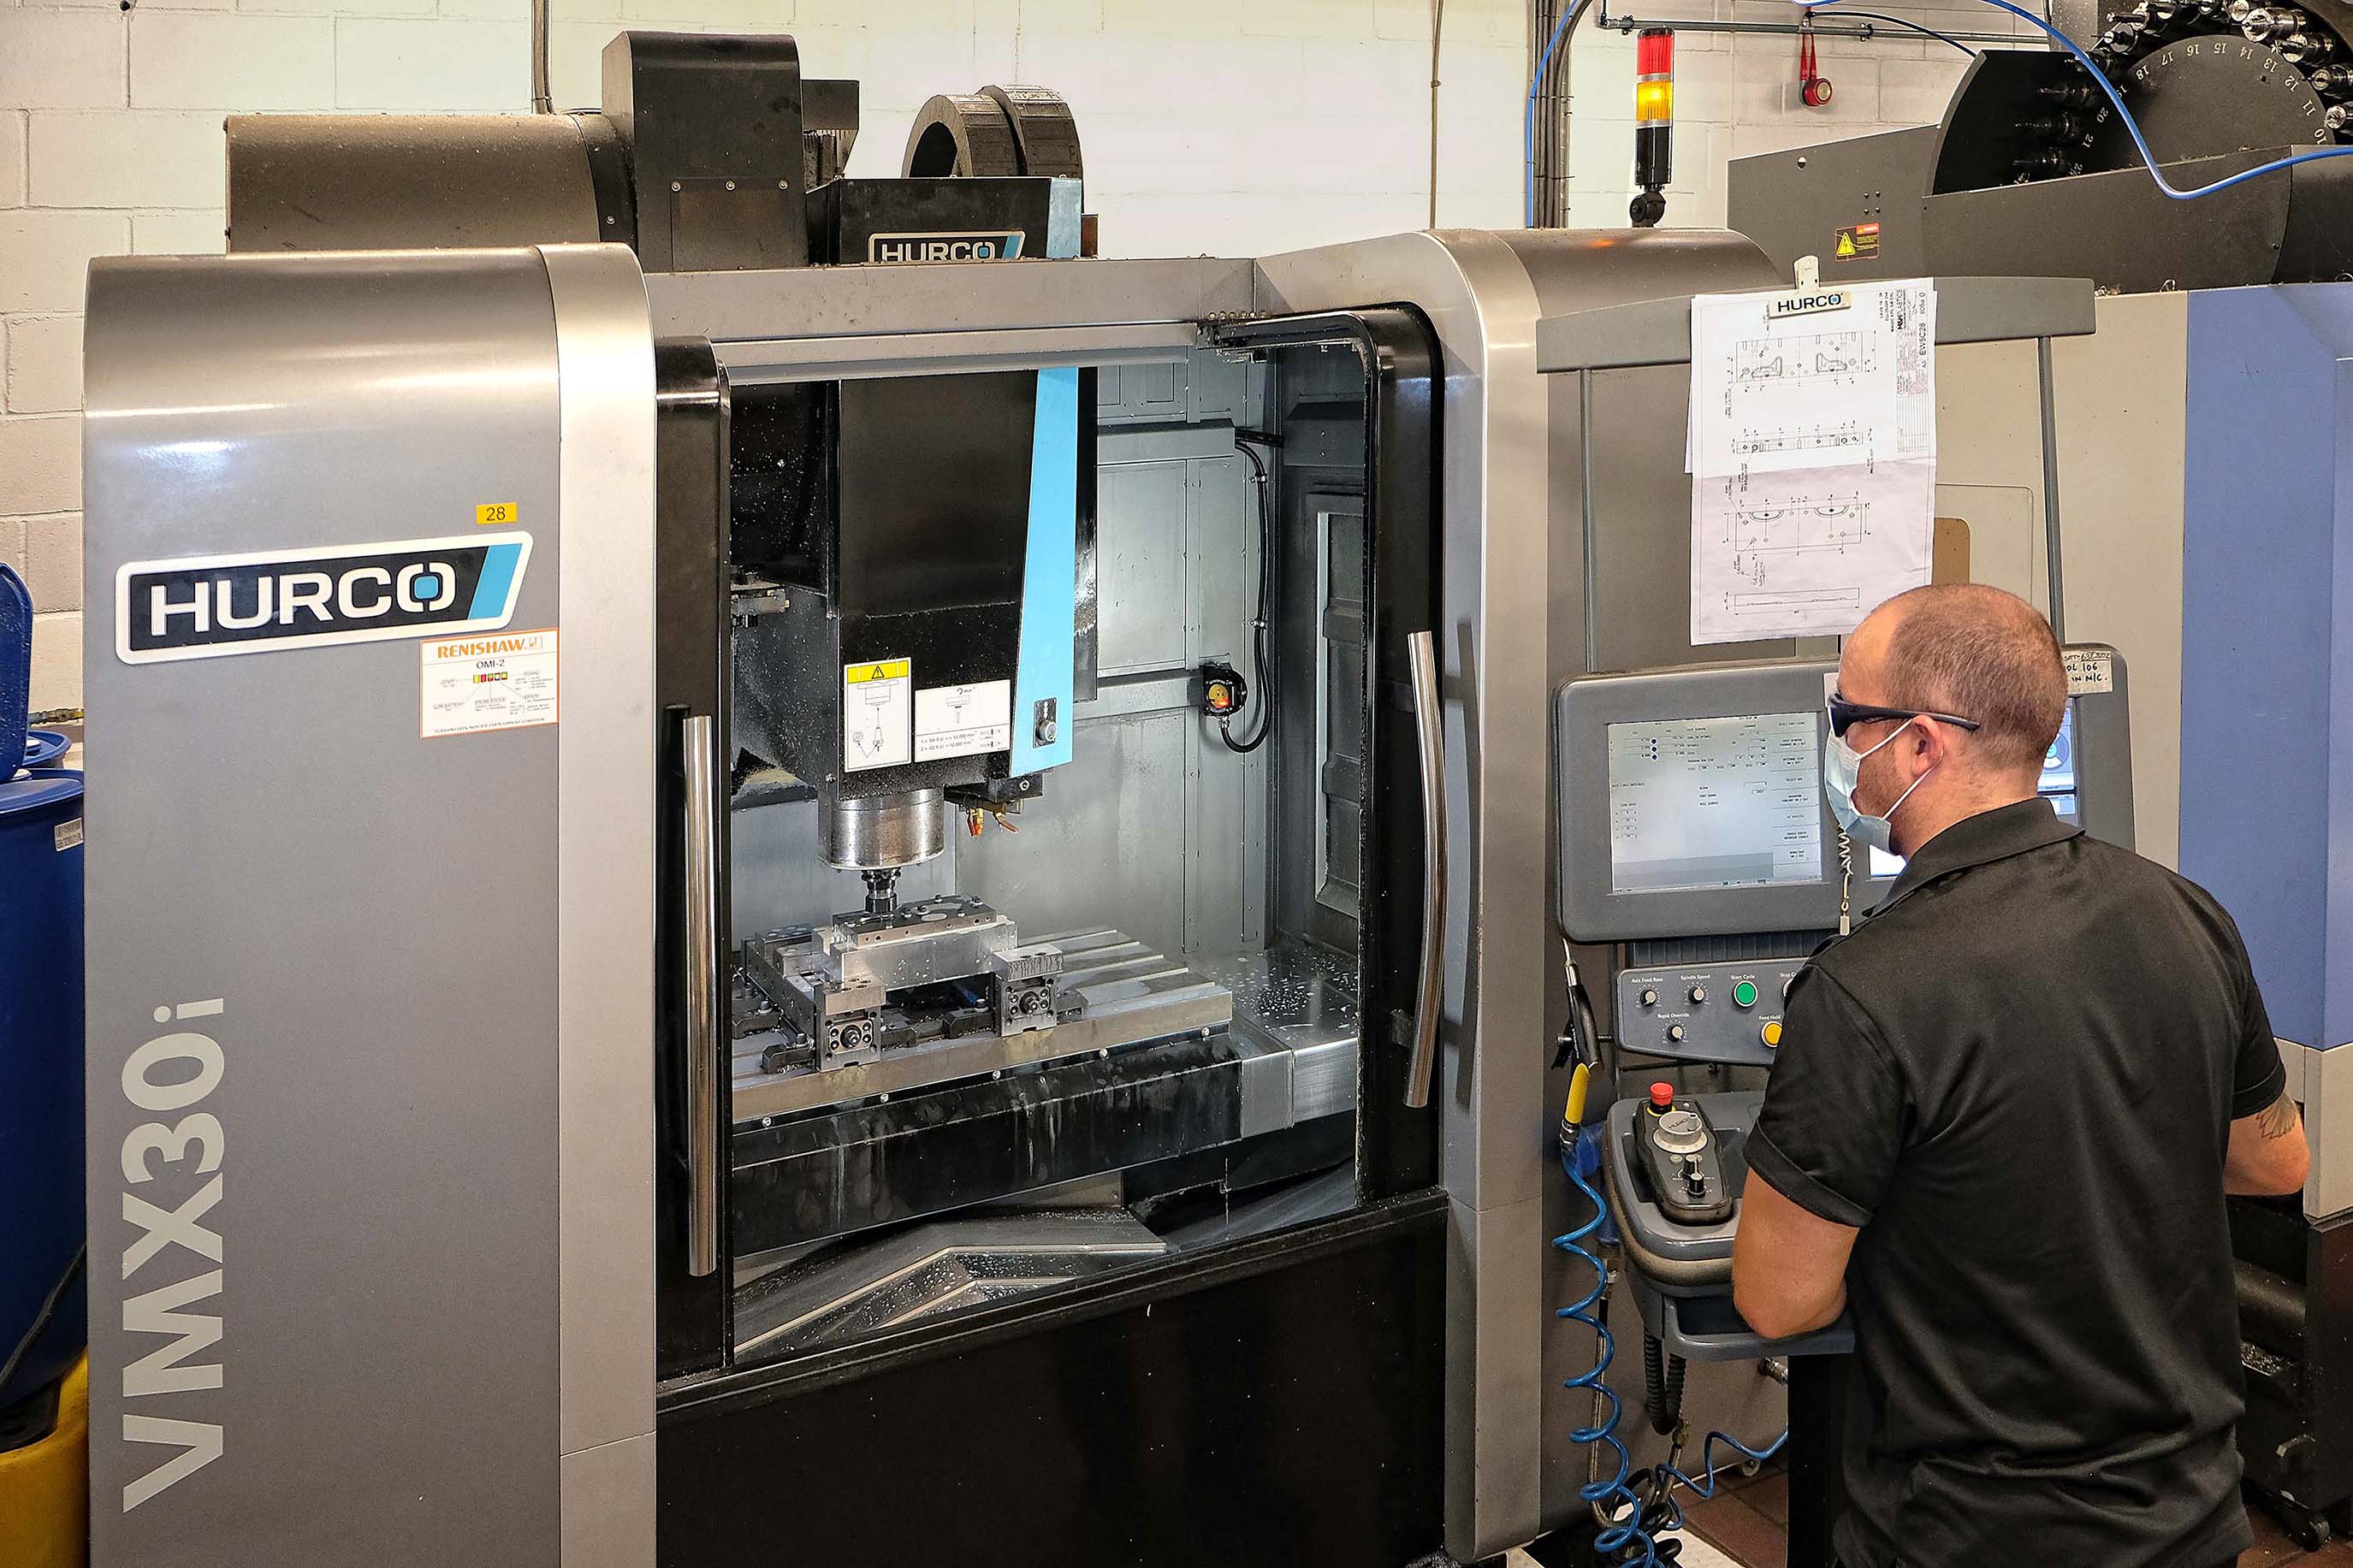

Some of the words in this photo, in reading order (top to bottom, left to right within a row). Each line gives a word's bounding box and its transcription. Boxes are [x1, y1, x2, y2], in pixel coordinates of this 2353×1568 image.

[2186, 44, 2200, 56] 16
[2214, 43, 2227, 54] 15
[2239, 46, 2255, 60] 14
[2161, 51, 2174, 66] 17
[2263, 57, 2279, 74] 13
[2136, 64, 2149, 80] 18
[2285, 74, 2301, 92] 12
[2096, 107, 2108, 123] 20
[2302, 99, 2316, 117] 11
[2082, 133, 2094, 148] 21
[2314, 128, 2327, 145] 10
[881, 242, 996, 263] HURCO
[1777, 293, 1841, 313] HURCO
[486, 506, 506, 521] 28
[150, 561, 456, 637] HURCO
[437, 638, 525, 659] RENISHAW
[476, 659, 505, 669] OMI-2
[2083, 662, 2097, 672] 106
[122, 997, 226, 1513] VMX30i
